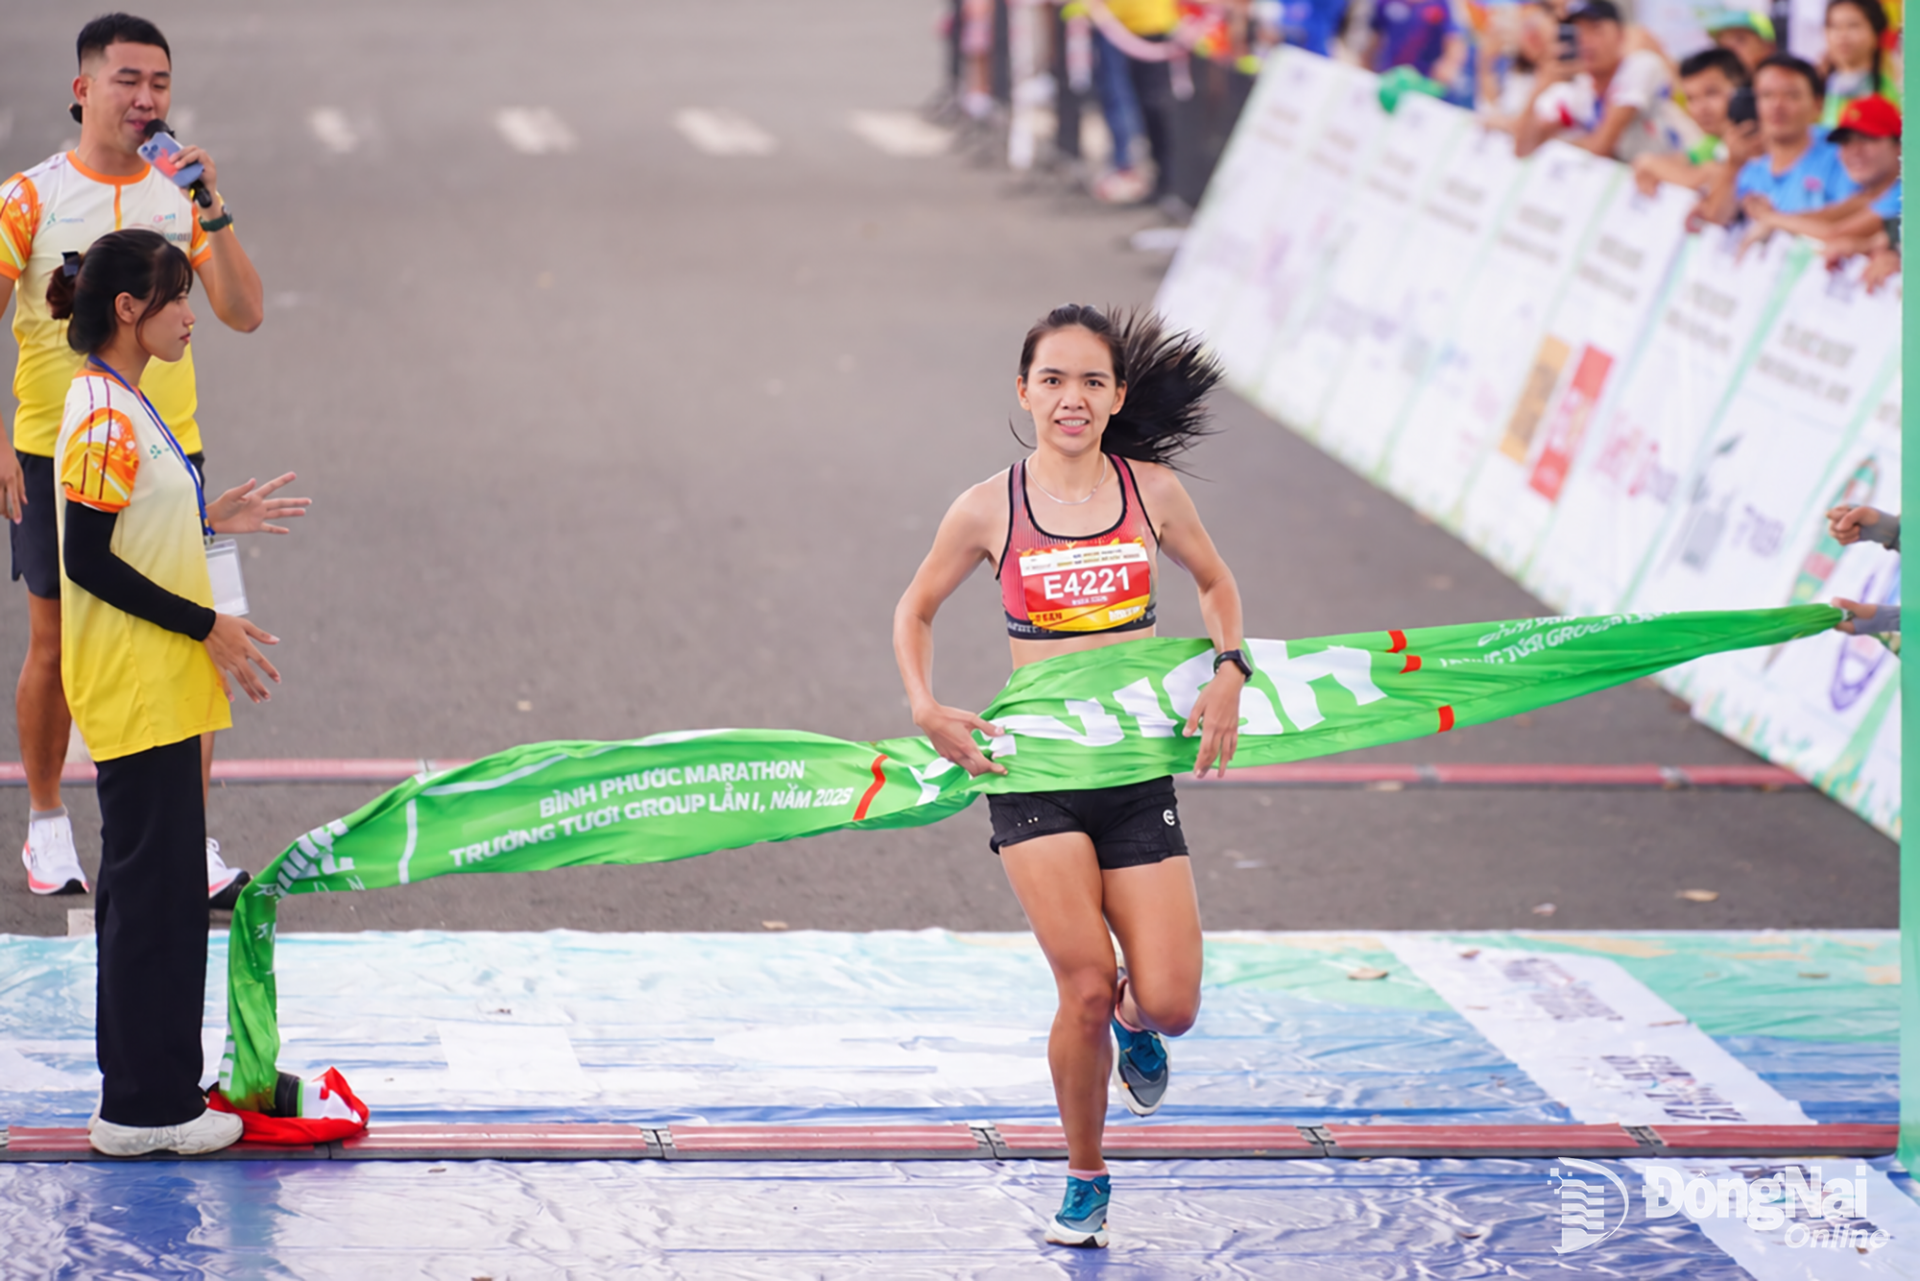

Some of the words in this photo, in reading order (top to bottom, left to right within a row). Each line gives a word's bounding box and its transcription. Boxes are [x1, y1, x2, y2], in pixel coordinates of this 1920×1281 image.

[1043, 566, 1129, 600] E4221
[539, 783, 597, 818] BÌNH
[600, 766, 682, 800] PHƯỚC
[684, 760, 805, 785] MARATHON
[624, 793, 706, 820] GROUP
[770, 782, 812, 810] NĂM
